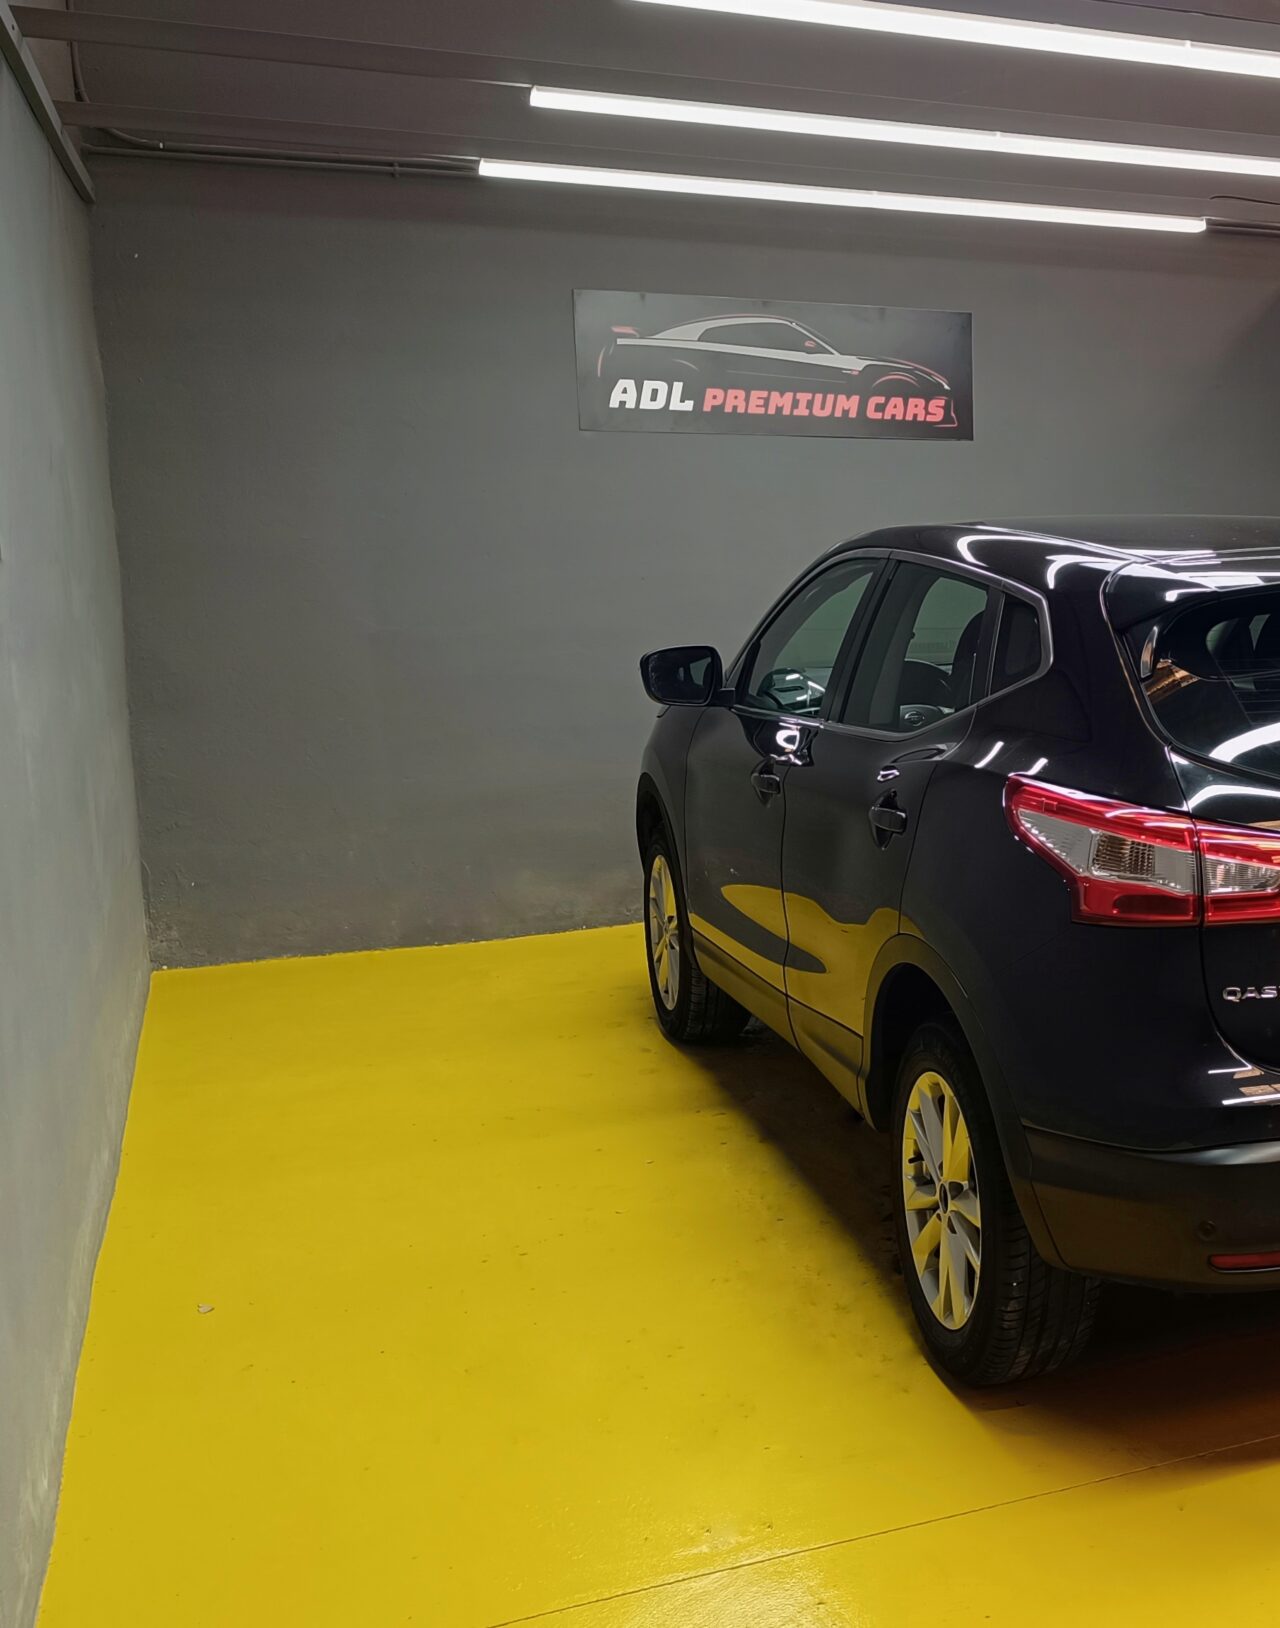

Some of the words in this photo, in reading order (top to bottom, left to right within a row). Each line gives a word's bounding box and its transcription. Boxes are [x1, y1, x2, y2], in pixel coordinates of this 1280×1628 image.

[609, 379, 694, 411] ADL
[703, 387, 860, 418] PREMIUM
[866, 395, 945, 422] CARS
